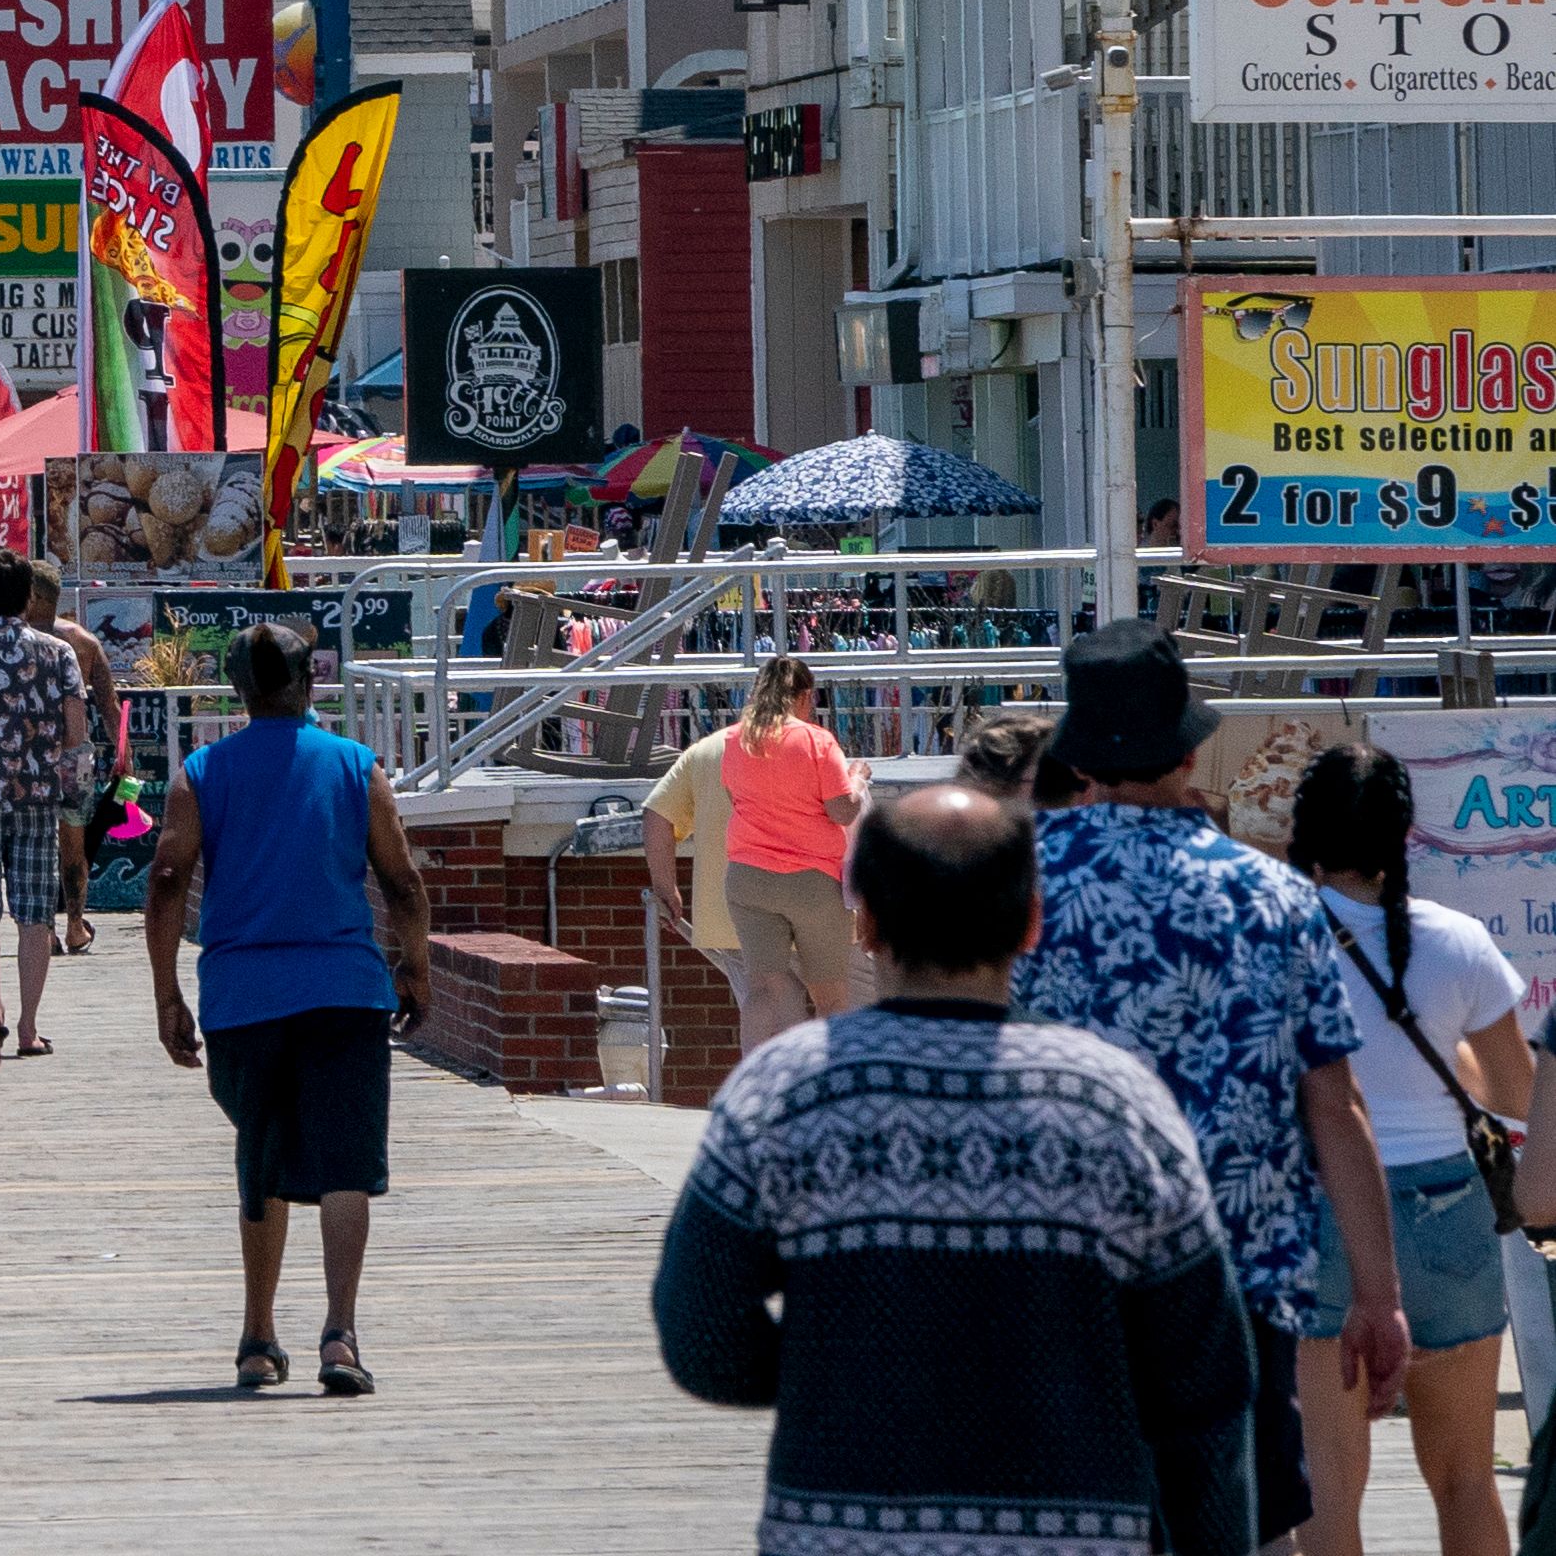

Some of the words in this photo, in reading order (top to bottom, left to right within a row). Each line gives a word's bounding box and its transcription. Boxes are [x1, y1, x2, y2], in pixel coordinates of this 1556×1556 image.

[1305, 12, 1556, 56] STO
[1241, 62, 1342, 92] Groceries
[1370, 62, 1478, 102] Cigarettes
[33, 283, 45, 308] S
[32, 311, 78, 339] CUS
[13, 343, 78, 368] TAFFY
[1270, 327, 1556, 423] Sunglas
[473, 426, 541, 445] BOARDWALK
[485, 415, 521, 428] POINT
[1274, 423, 1344, 452] Best
[1360, 422, 1513, 453] selection
[1220, 463, 1260, 527] 2
[1282, 482, 1359, 527] for
[1378, 463, 1459, 532] $9
[172, 605, 220, 627] BODY
